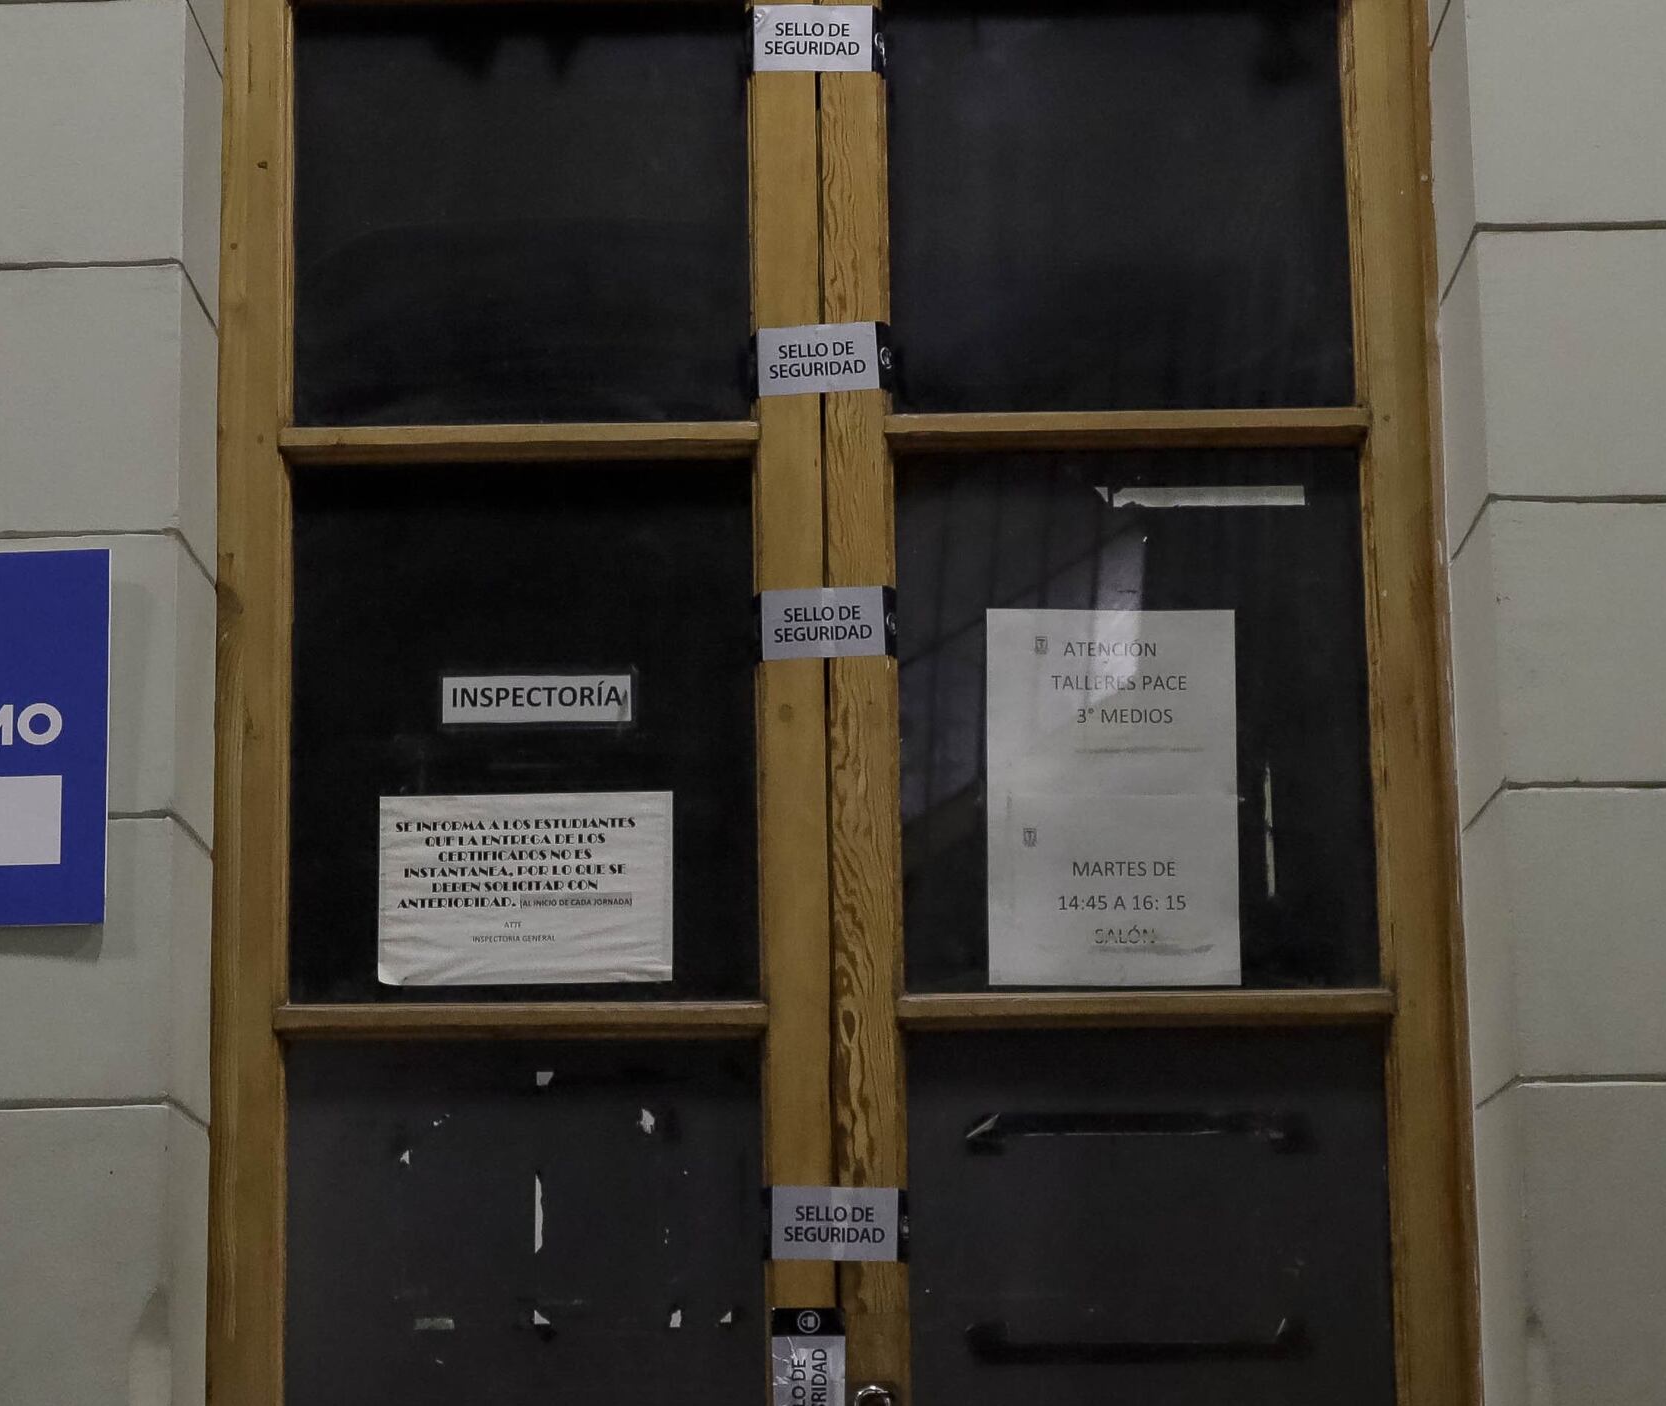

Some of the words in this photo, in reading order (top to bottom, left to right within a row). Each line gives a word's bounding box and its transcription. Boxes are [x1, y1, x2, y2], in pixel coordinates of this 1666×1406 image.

[775, 22, 824, 37] SELLO
[829, 23, 850, 37] DE
[764, 40, 860, 56] SEGURIDAD
[778, 342, 829, 360] SELLO
[833, 341, 855, 356] DE
[769, 359, 866, 379] SEGURIDAD
[783, 606, 835, 623] SELLO
[839, 605, 861, 621] DE
[773, 624, 873, 644] SEGURIDAD
[1063, 638, 1157, 657] ATENCIÓN
[1051, 675, 1136, 691] TALLERES
[1142, 675, 1187, 691] PACE
[451, 681, 623, 708] INSPECTORÍA
[1101, 708, 1174, 724] MEDIOS
[395, 821, 413, 832] SE
[416, 820, 485, 832] INFORMA
[489, 819, 501, 831] A
[503, 818, 531, 831] LOS
[534, 817, 636, 830] ESTUDIANTES
[425, 835, 455, 848] QUE
[458, 834, 479, 847] LA
[482, 833, 552, 846] ENTREGA
[555, 833, 575, 845] DE
[578, 832, 606, 845] LOS
[438, 849, 547, 863] CERTIFICADOS
[550, 848, 572, 861] NO
[575, 847, 593, 860] ES
[517, 864, 549, 876] POR
[552, 864, 572, 876] LO
[575, 863, 606, 876] QUE
[609, 863, 627, 875] SE
[1072, 861, 1147, 877] MARTES
[1153, 861, 1176, 877] DE
[432, 881, 481, 893] DEBEN
[484, 879, 564, 893] SOLICITAR
[567, 879, 598, 891] CON
[397, 896, 515, 909] ANTERIORIDAD.
[533, 898, 557, 907] INICIO
[559, 899, 570, 907] DE
[571, 898, 592, 907] CADA
[1058, 895, 1108, 911] 14:45
[1113, 895, 1127, 911] A
[1165, 895, 1187, 911] 15
[522, 934, 556, 943] GENERAL
[1095, 925, 1156, 944] SALÓN
[795, 1205, 847, 1223] SELLO
[852, 1206, 875, 1223] DE
[784, 1226, 886, 1244] SEGURIDAD
[790, 1358, 807, 1382] DE
